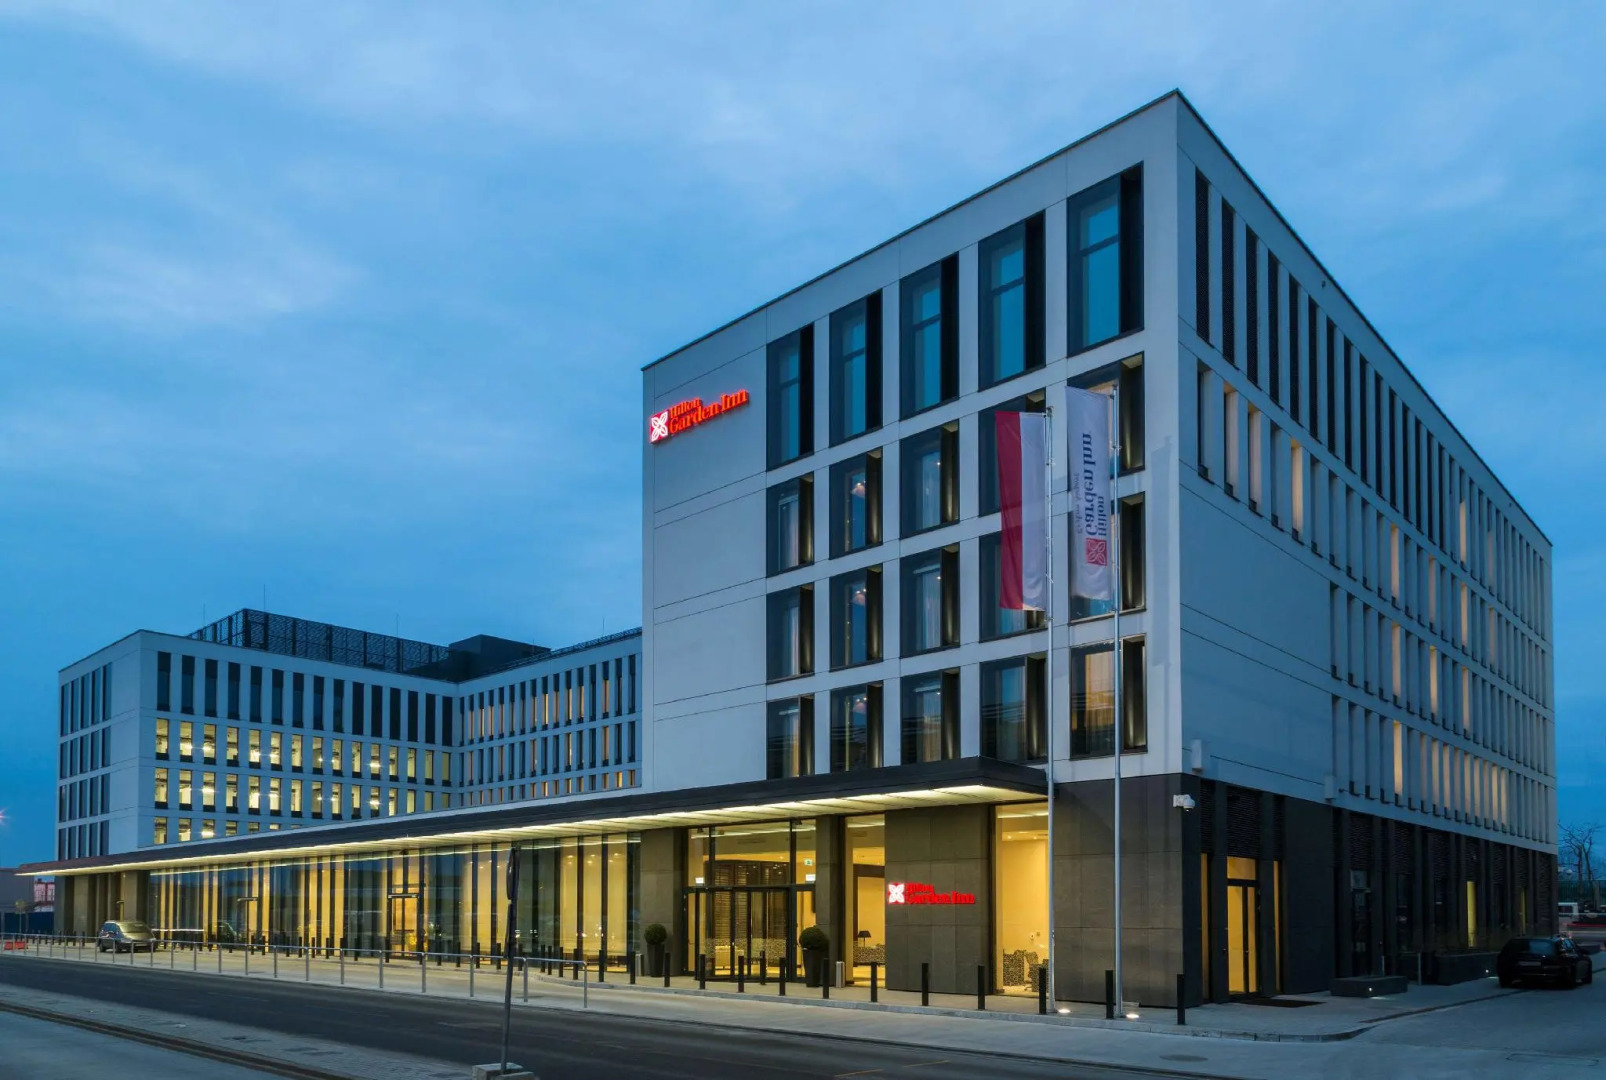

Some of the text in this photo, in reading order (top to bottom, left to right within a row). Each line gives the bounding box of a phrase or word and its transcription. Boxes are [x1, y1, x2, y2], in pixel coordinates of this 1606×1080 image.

[670, 397, 702, 418] Hilton
[670, 389, 748, 434] Garden Inn
[906, 890, 975, 904] Garden Inn
